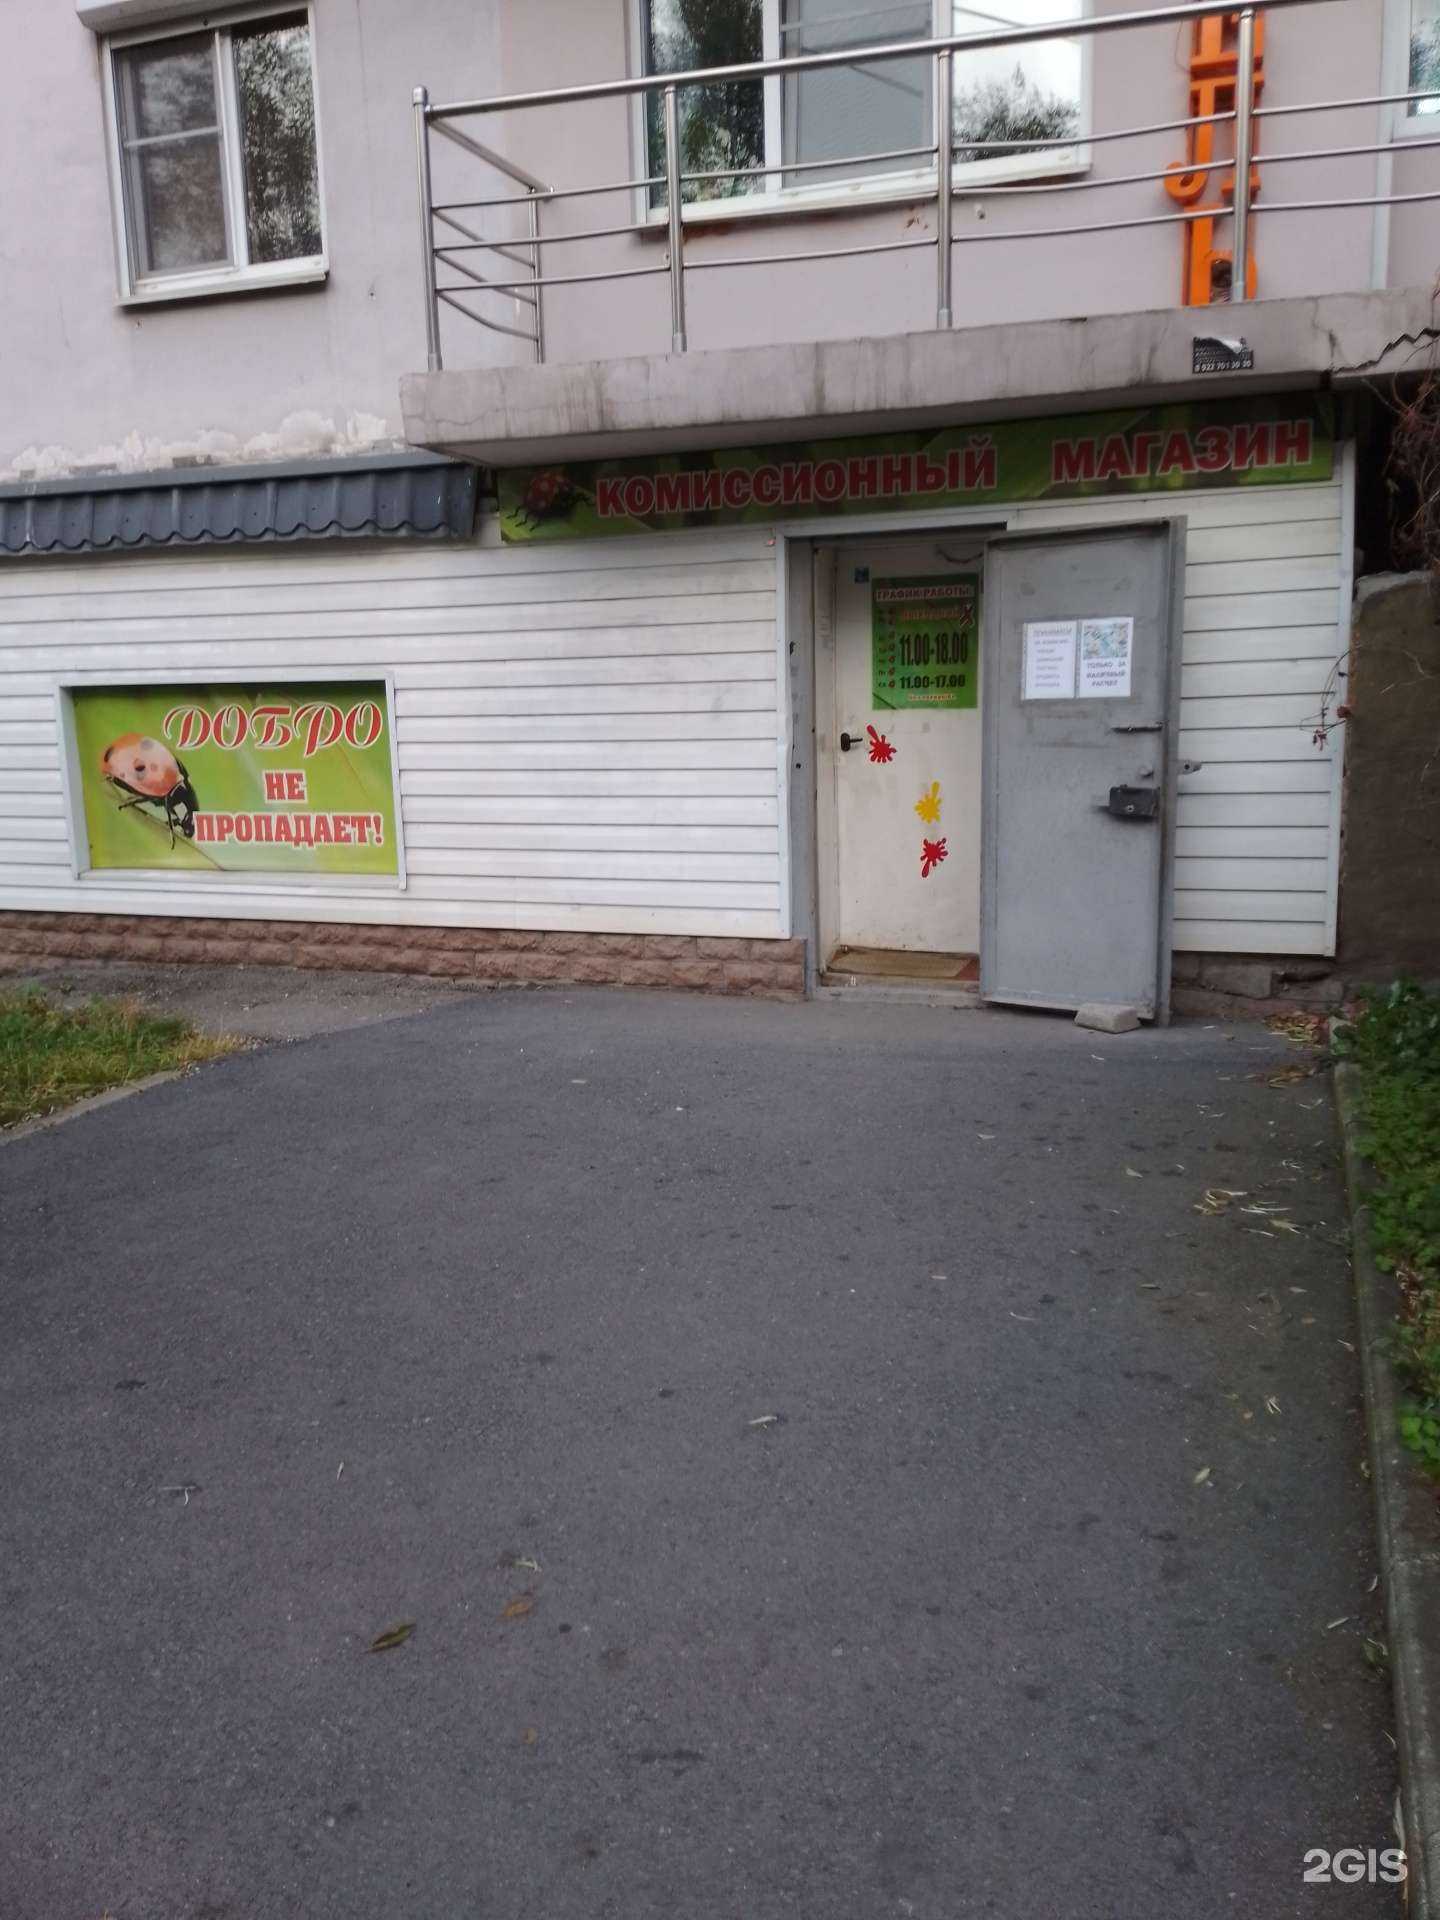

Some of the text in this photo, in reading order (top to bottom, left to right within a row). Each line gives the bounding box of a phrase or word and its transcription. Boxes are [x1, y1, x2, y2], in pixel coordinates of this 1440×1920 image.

[597, 419, 1314, 517] КОМИССИОННЫЙ МАГАЗИН
[899, 674, 966, 689] 11.00-17.00
[163, 700, 383, 758] ДОБРО
[264, 769, 307, 804] НЕ
[193, 811, 385, 848] ПРОПАДАЕТ!
